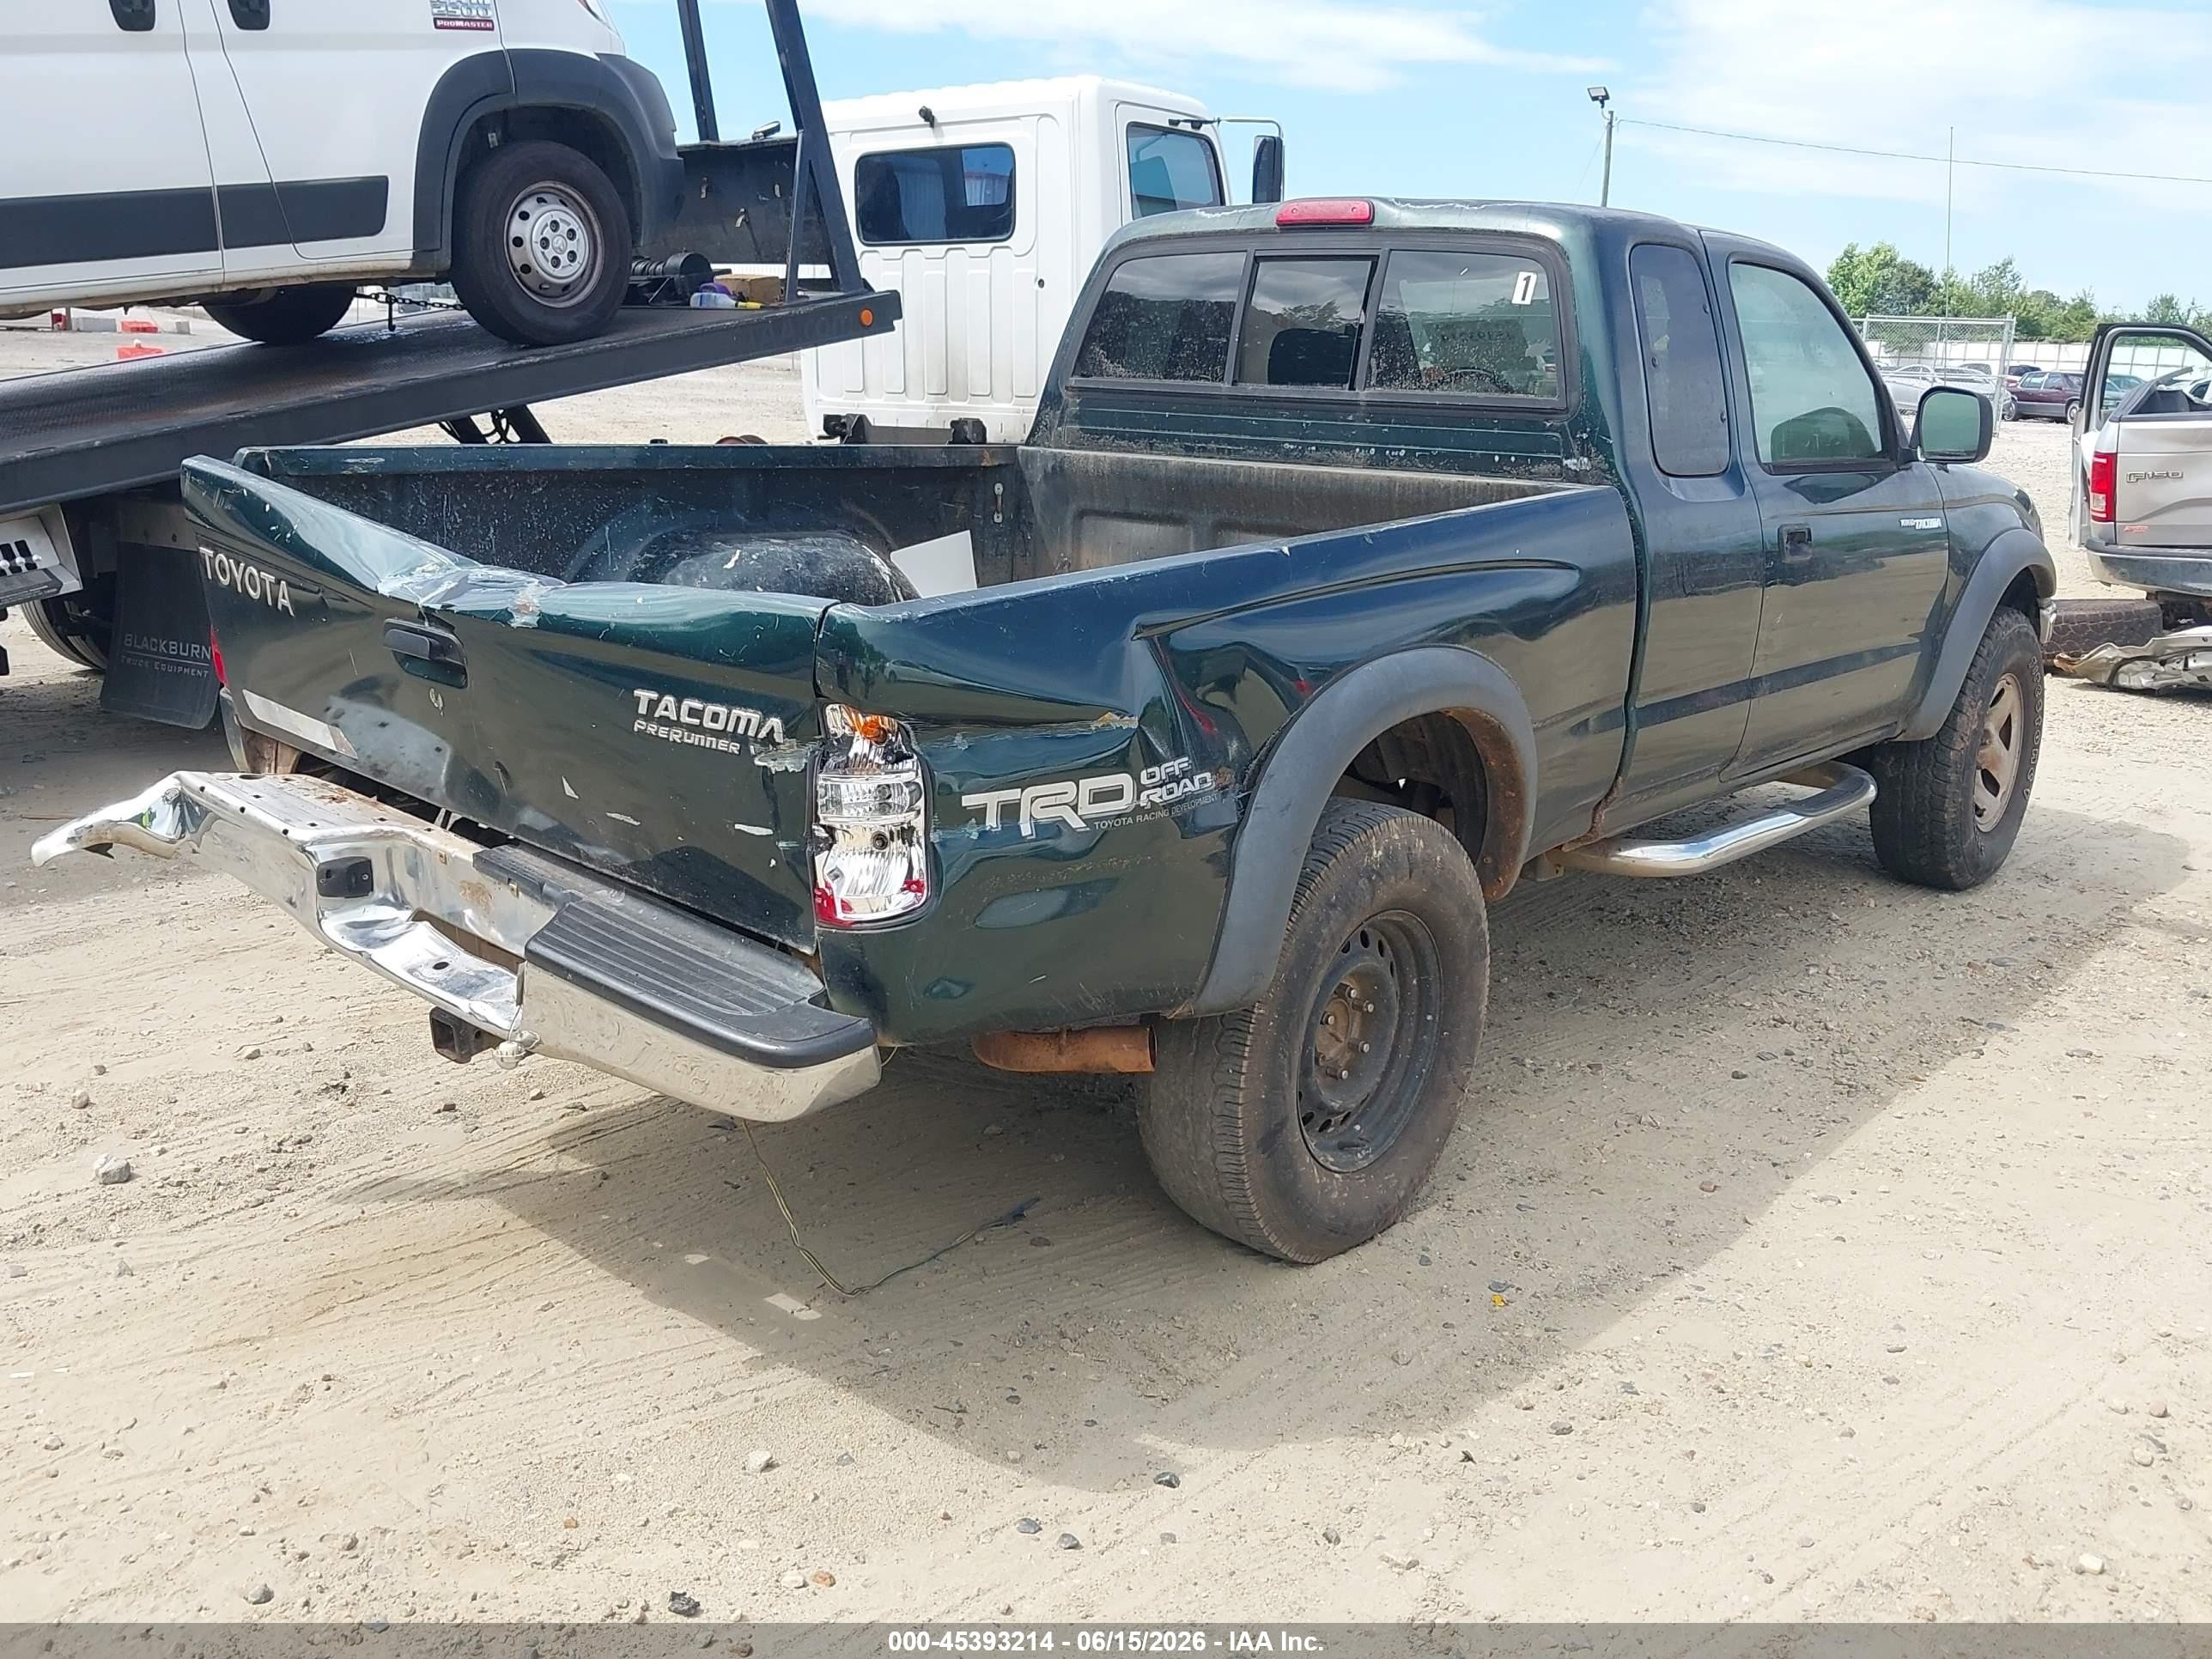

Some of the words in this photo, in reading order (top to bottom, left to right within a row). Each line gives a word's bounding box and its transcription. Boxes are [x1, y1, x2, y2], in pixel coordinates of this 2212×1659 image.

[431, 4, 493, 18] 2500
[1521, 275, 1532, 301] 1
[198, 546, 295, 617] TOYOTA
[123, 634, 211, 660] BLACKBURN
[155, 661, 209, 678] EQUIPMENT
[633, 688, 785, 744] TACOMA
[1140, 757, 1193, 787] OFF
[961, 773, 1138, 839] TRD
[1139, 772, 1216, 810] ROAD
[1094, 817, 1133, 830] TOYOTA
[1136, 808, 1170, 823] RACING
[1171, 793, 1218, 816] DEVELOPMENT
